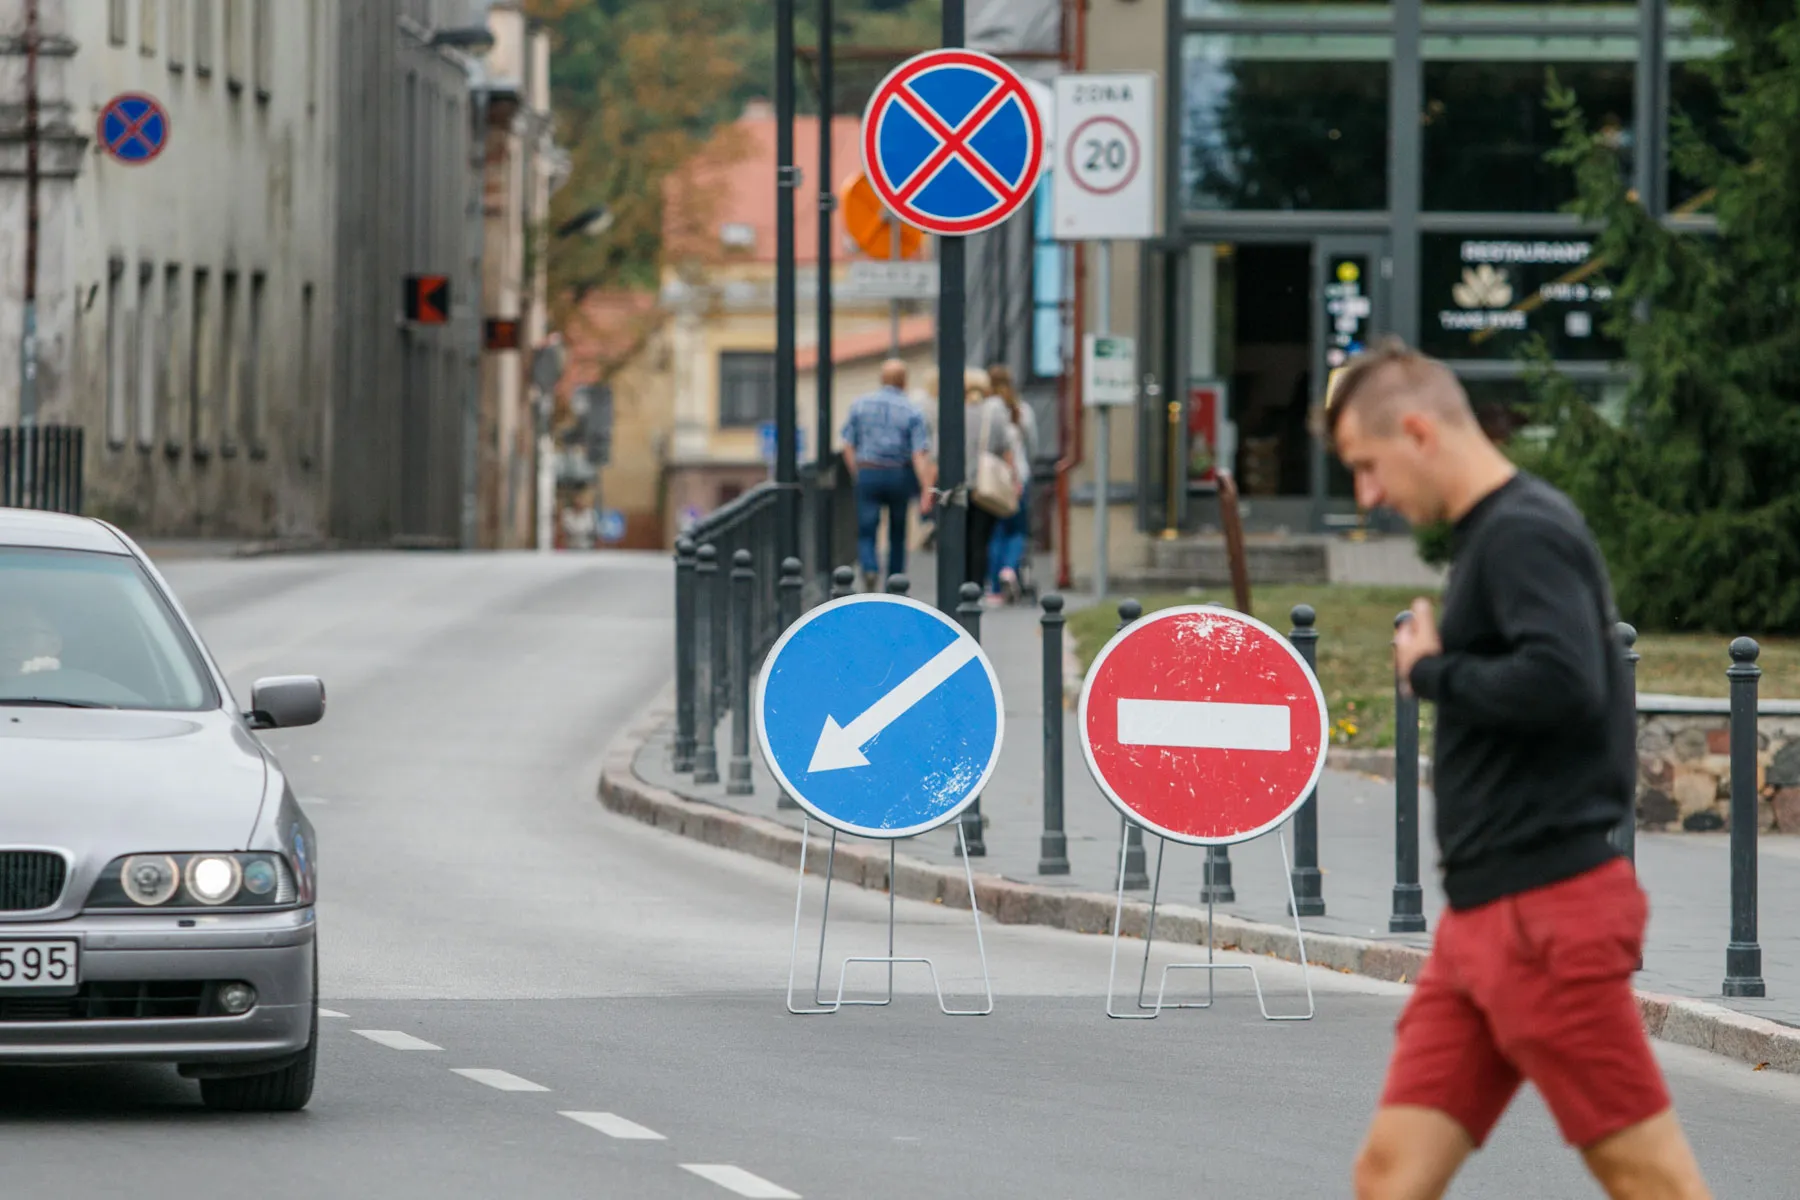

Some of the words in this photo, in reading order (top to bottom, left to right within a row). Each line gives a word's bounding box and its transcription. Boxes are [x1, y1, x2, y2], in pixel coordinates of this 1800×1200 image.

[1073, 85, 1133, 103] ZONA
[1085, 139, 1126, 171] 20
[1461, 241, 1590, 262] RESTAURANT
[0, 947, 68, 980] 595
